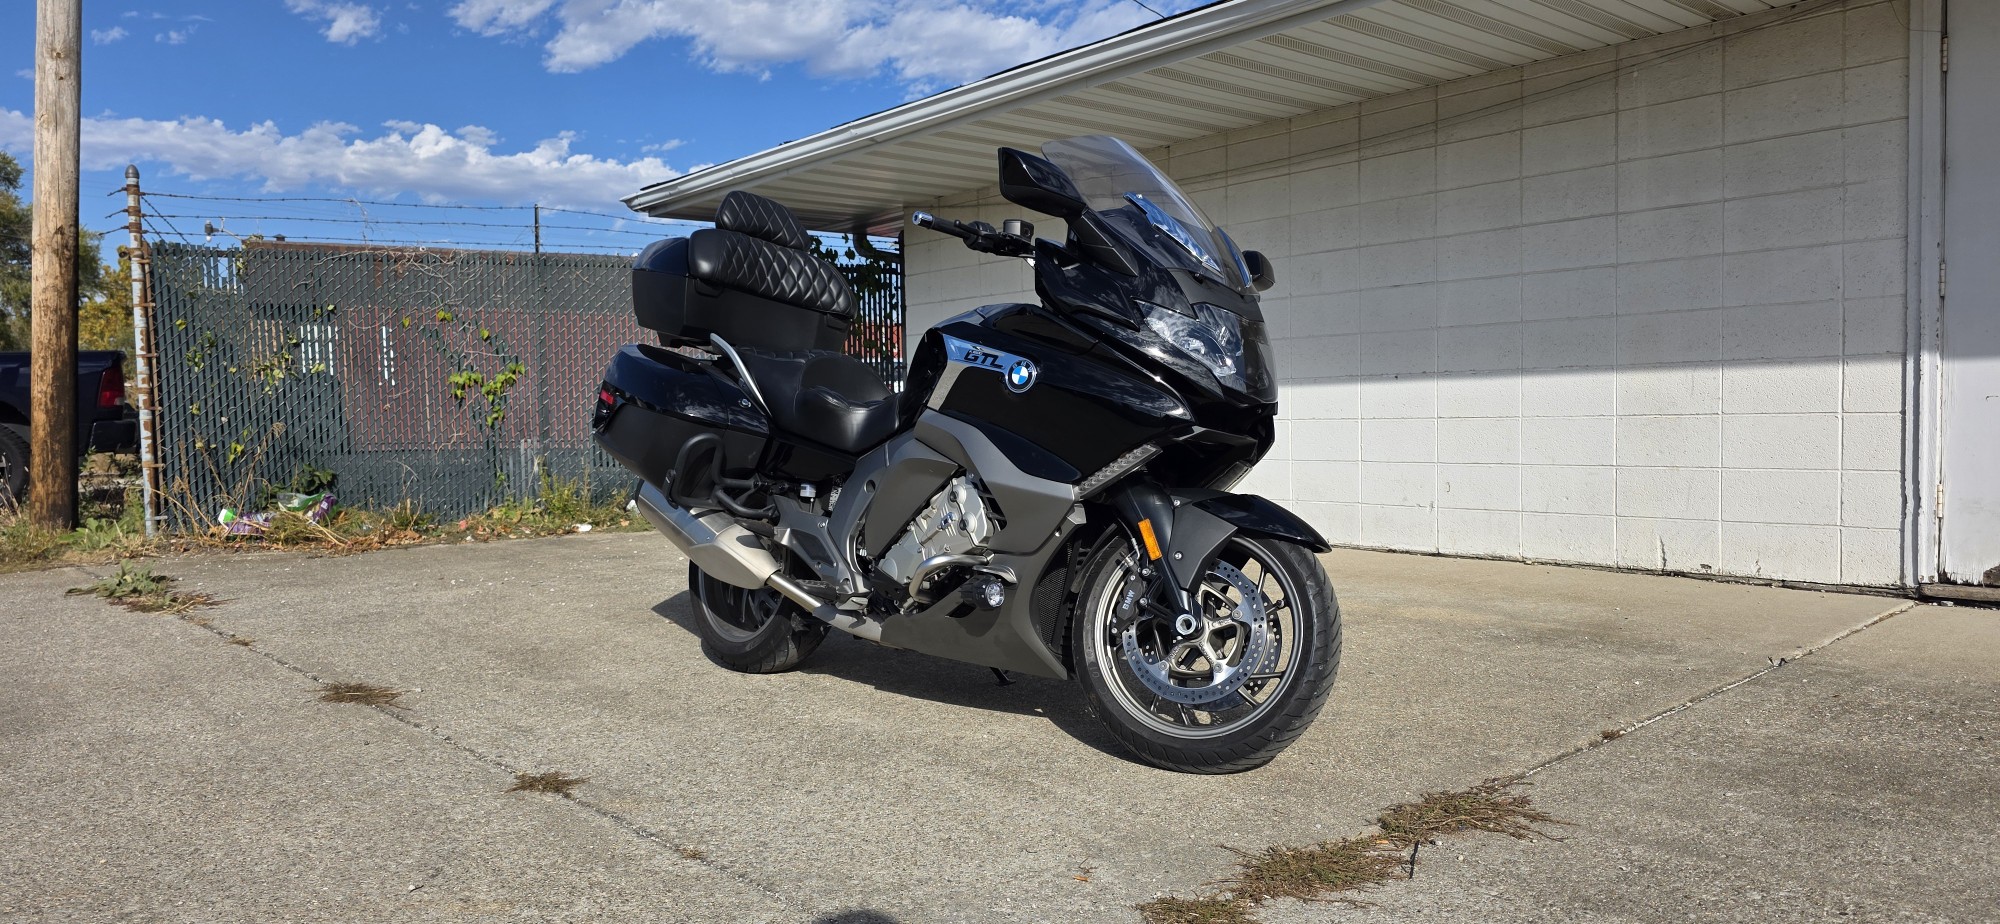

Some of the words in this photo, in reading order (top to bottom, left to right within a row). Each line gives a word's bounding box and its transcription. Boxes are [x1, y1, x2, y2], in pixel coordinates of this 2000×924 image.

[964, 349, 1004, 369] GTL
[1012, 361, 1034, 373] BMW
[1122, 590, 1135, 610] BMW
